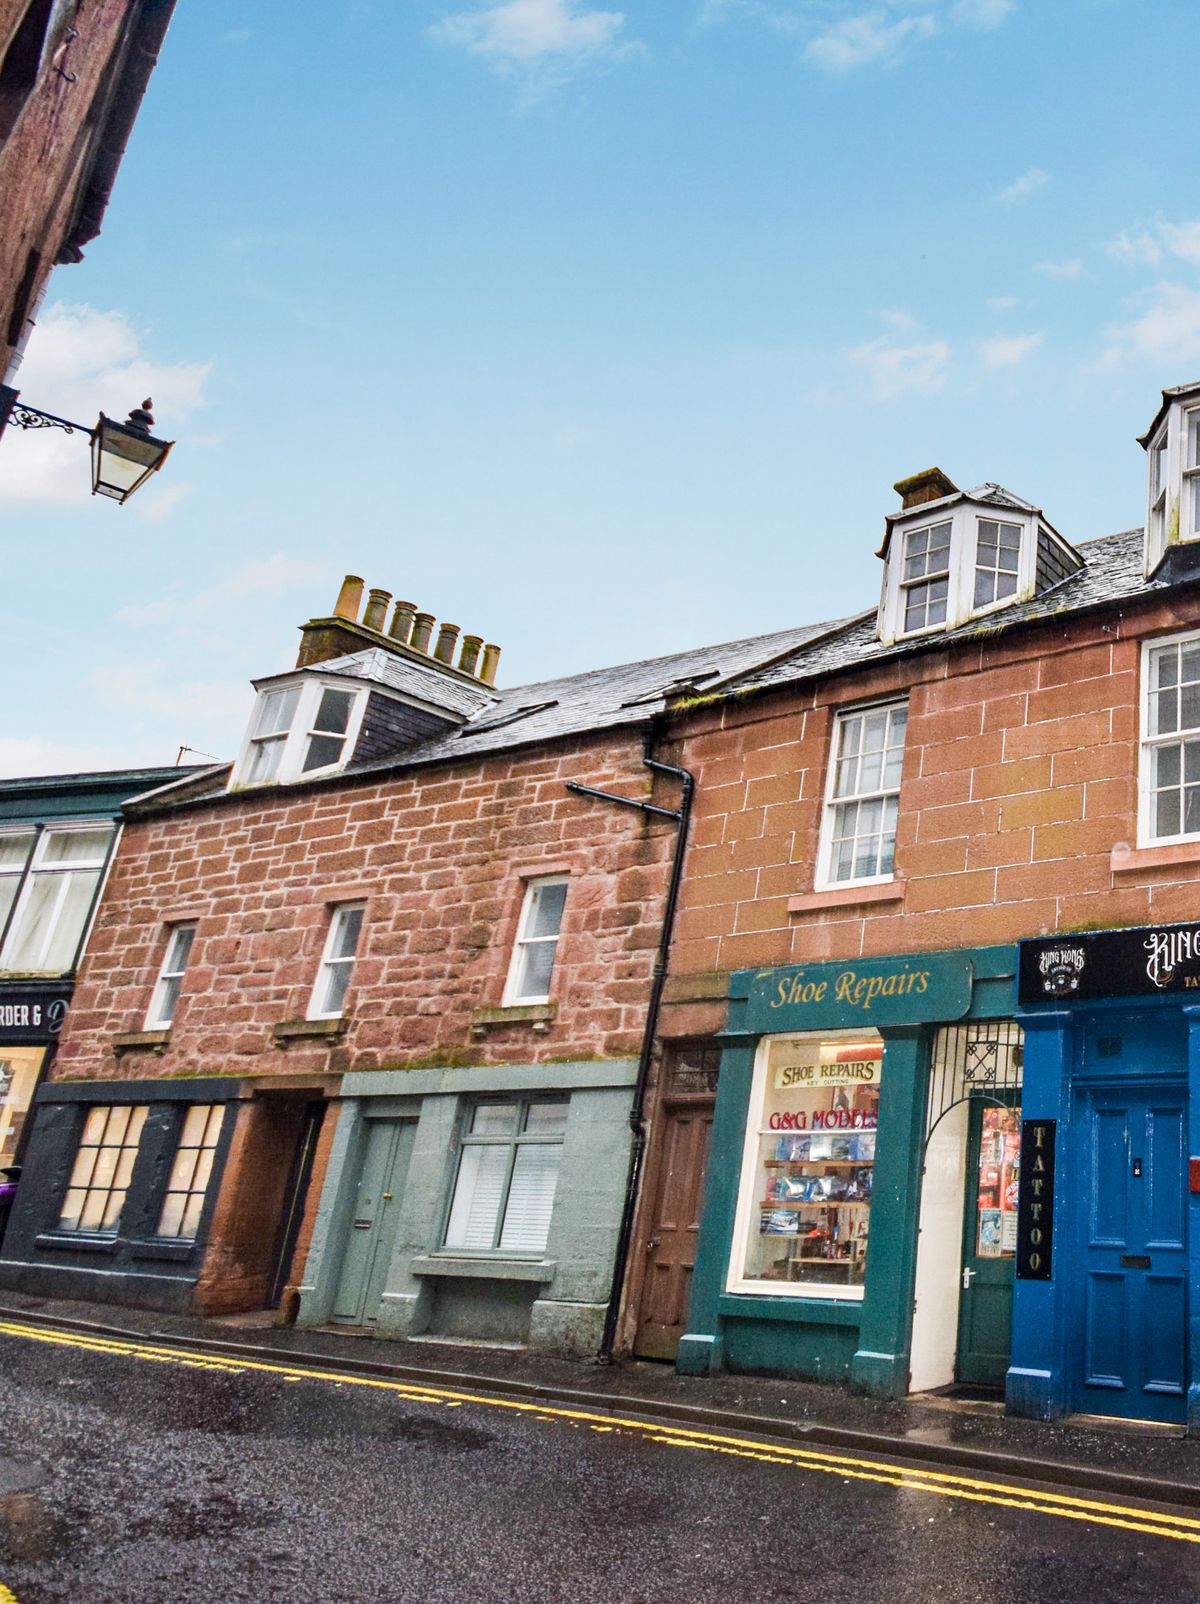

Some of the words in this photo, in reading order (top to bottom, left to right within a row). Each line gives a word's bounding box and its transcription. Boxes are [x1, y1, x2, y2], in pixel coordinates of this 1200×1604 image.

[1039, 951, 1059, 975] KING
[1060, 947, 1085, 970] KONG
[770, 972, 827, 1008] Shoe
[835, 964, 930, 1008] Repairs
[33, 1005, 42, 1026] &
[782, 1066, 814, 1086] SHOE
[821, 1061, 875, 1081] REPAIRS
[769, 1111, 807, 1130] G&G
[811, 1108, 878, 1130] MODELS
[1028, 1127, 1046, 1270] TATTOO
